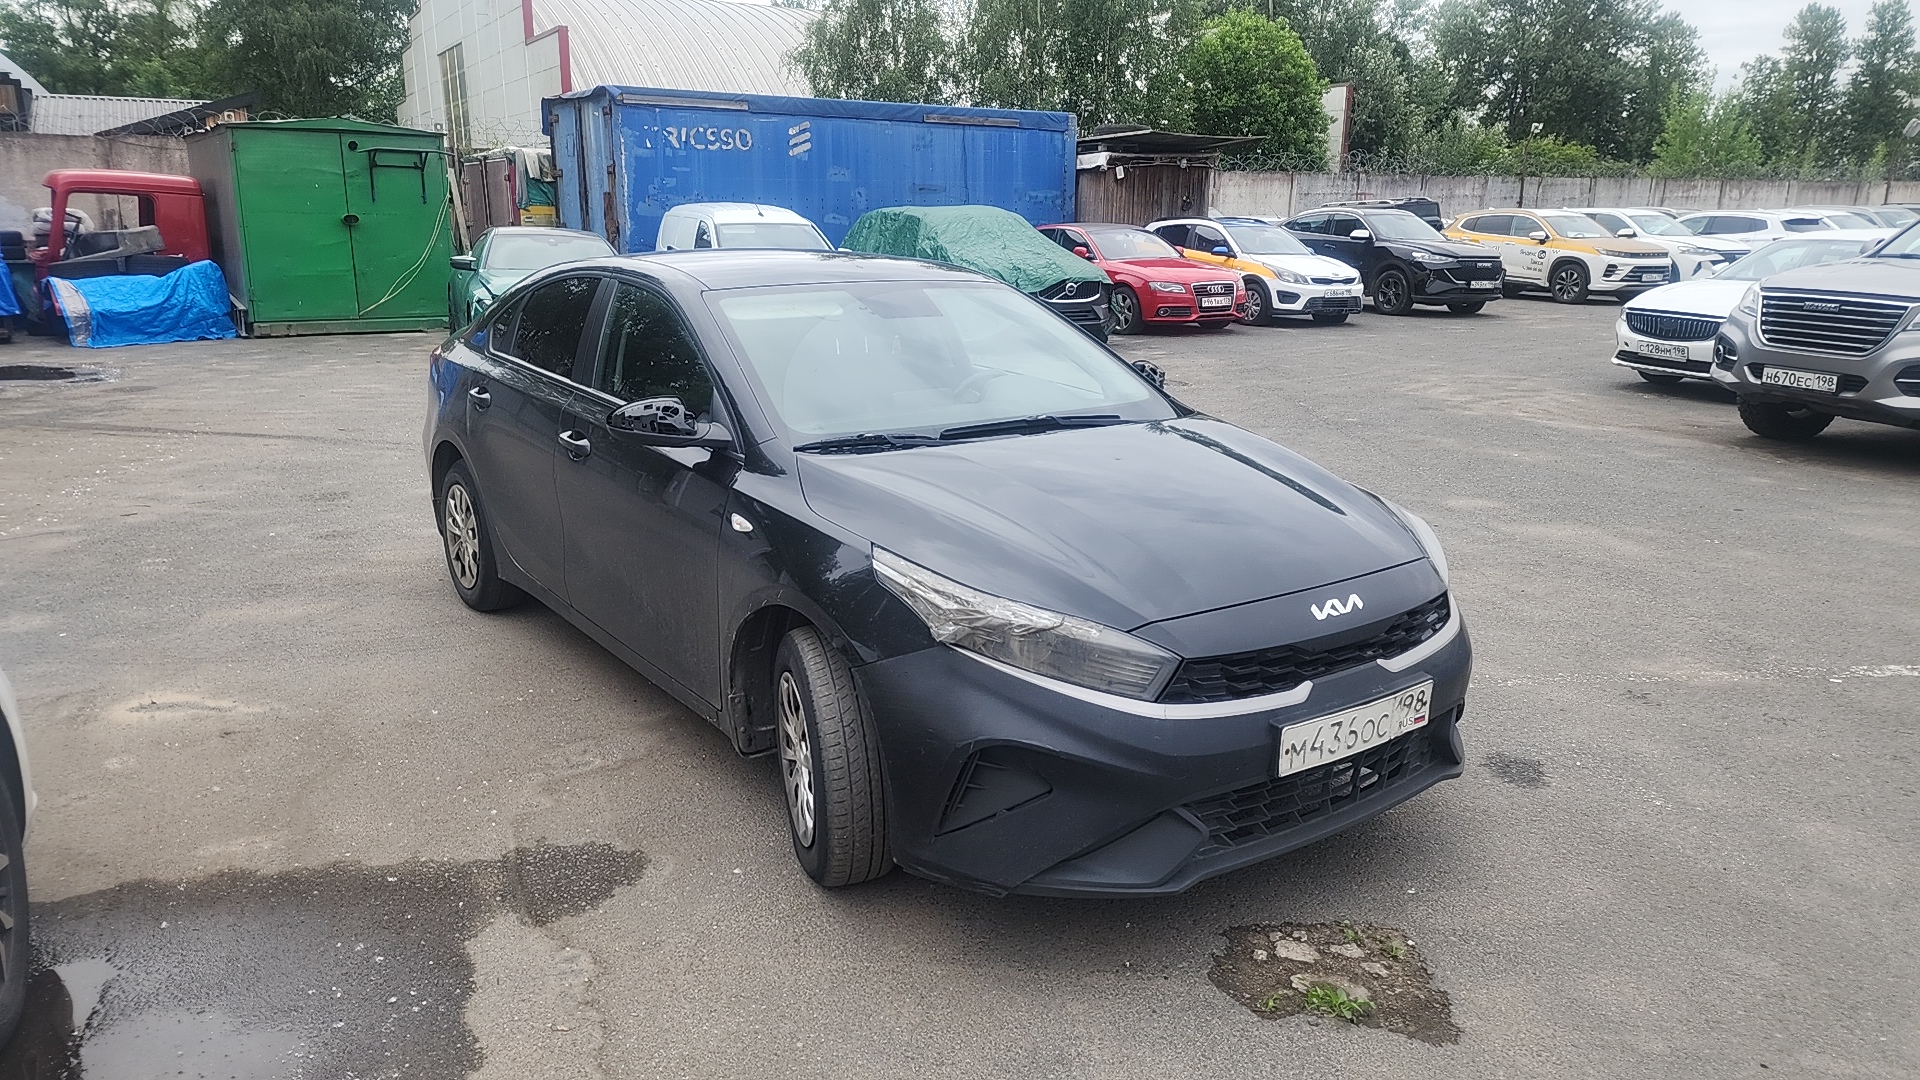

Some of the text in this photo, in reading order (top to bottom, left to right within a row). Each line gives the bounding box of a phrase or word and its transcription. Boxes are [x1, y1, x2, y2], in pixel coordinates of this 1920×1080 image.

[1673, 347, 1686, 355] 198
[1765, 371, 1835, 387] Н670ЕС 198
[1310, 594, 1364, 620] KIA
[1396, 690, 1425, 718] 198
